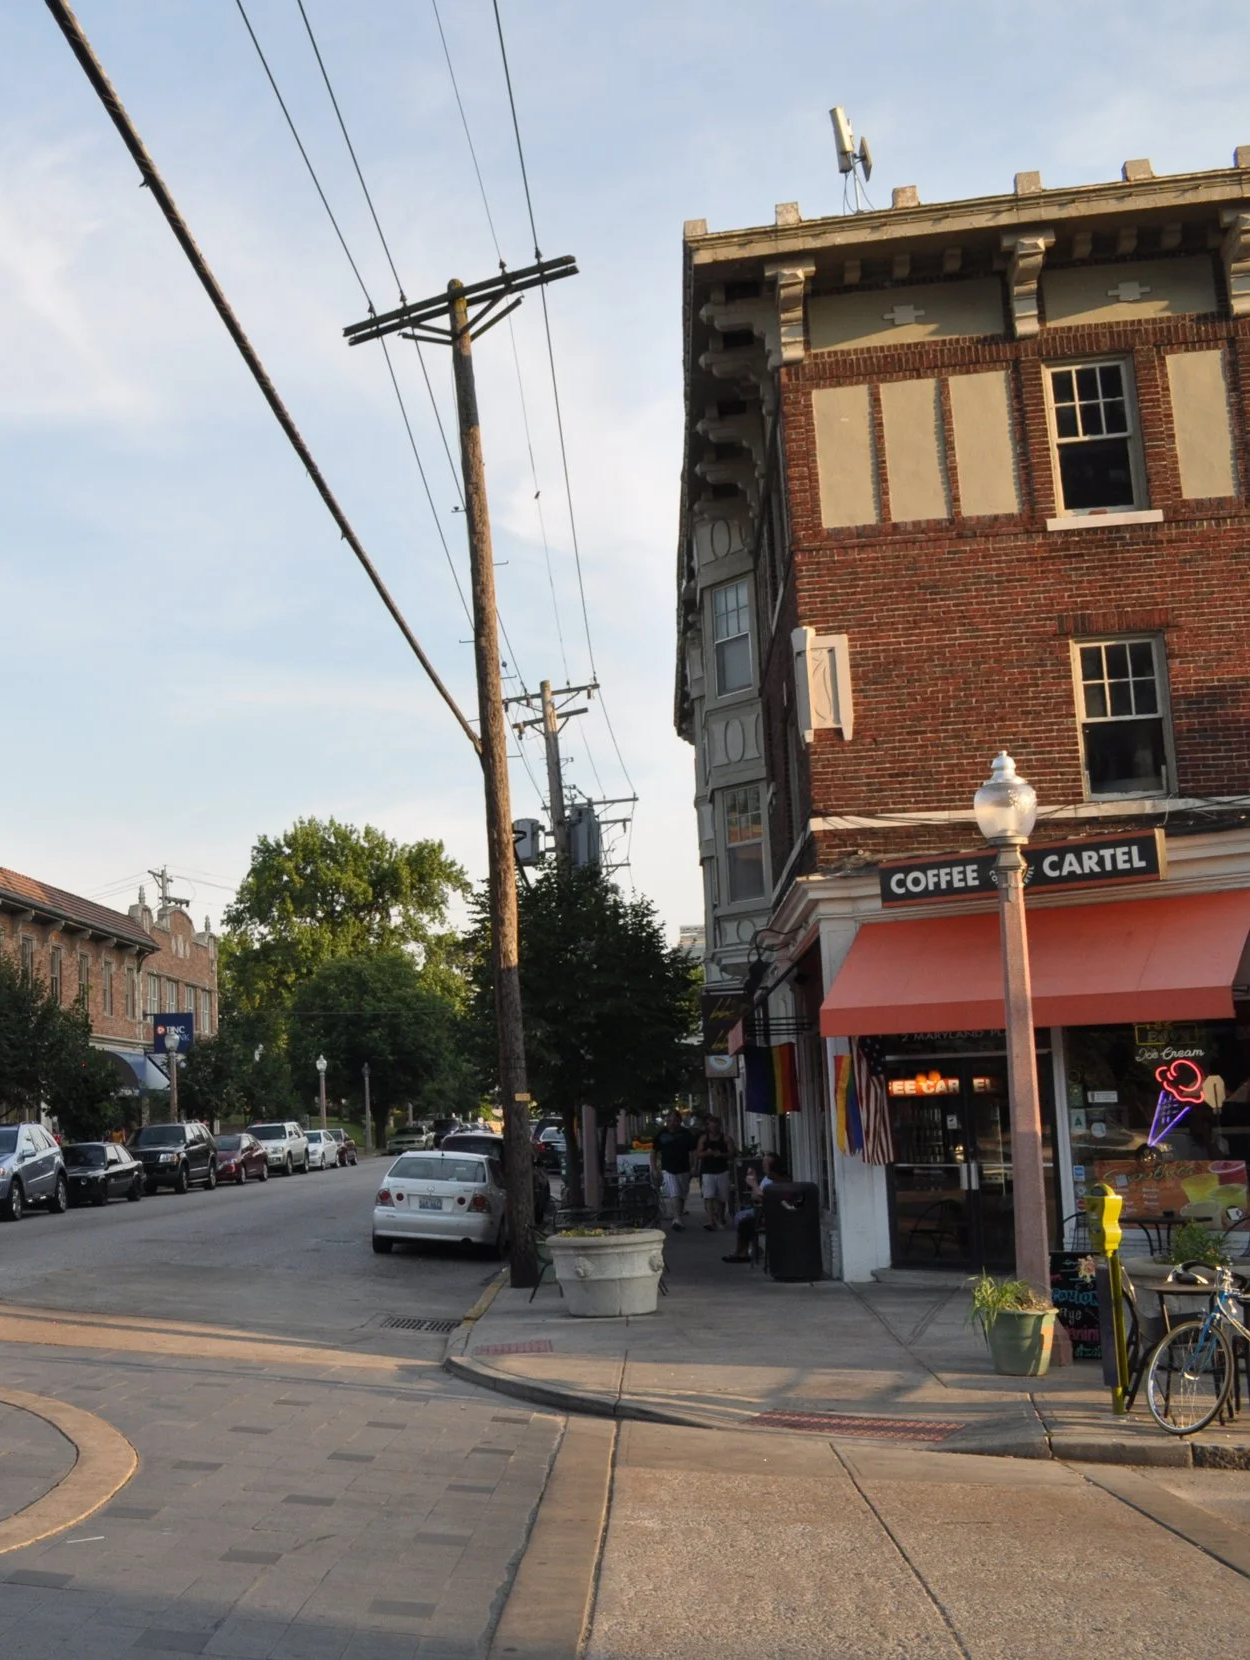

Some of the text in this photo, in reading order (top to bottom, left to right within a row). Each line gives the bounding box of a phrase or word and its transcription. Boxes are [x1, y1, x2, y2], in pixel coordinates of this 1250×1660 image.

[890, 864, 980, 894] COFFEE
[1042, 845, 1147, 878] CARTEL
[913, 1029, 985, 1041] MARYLAND
[1134, 1046, 1205, 1062] Ice Cream
